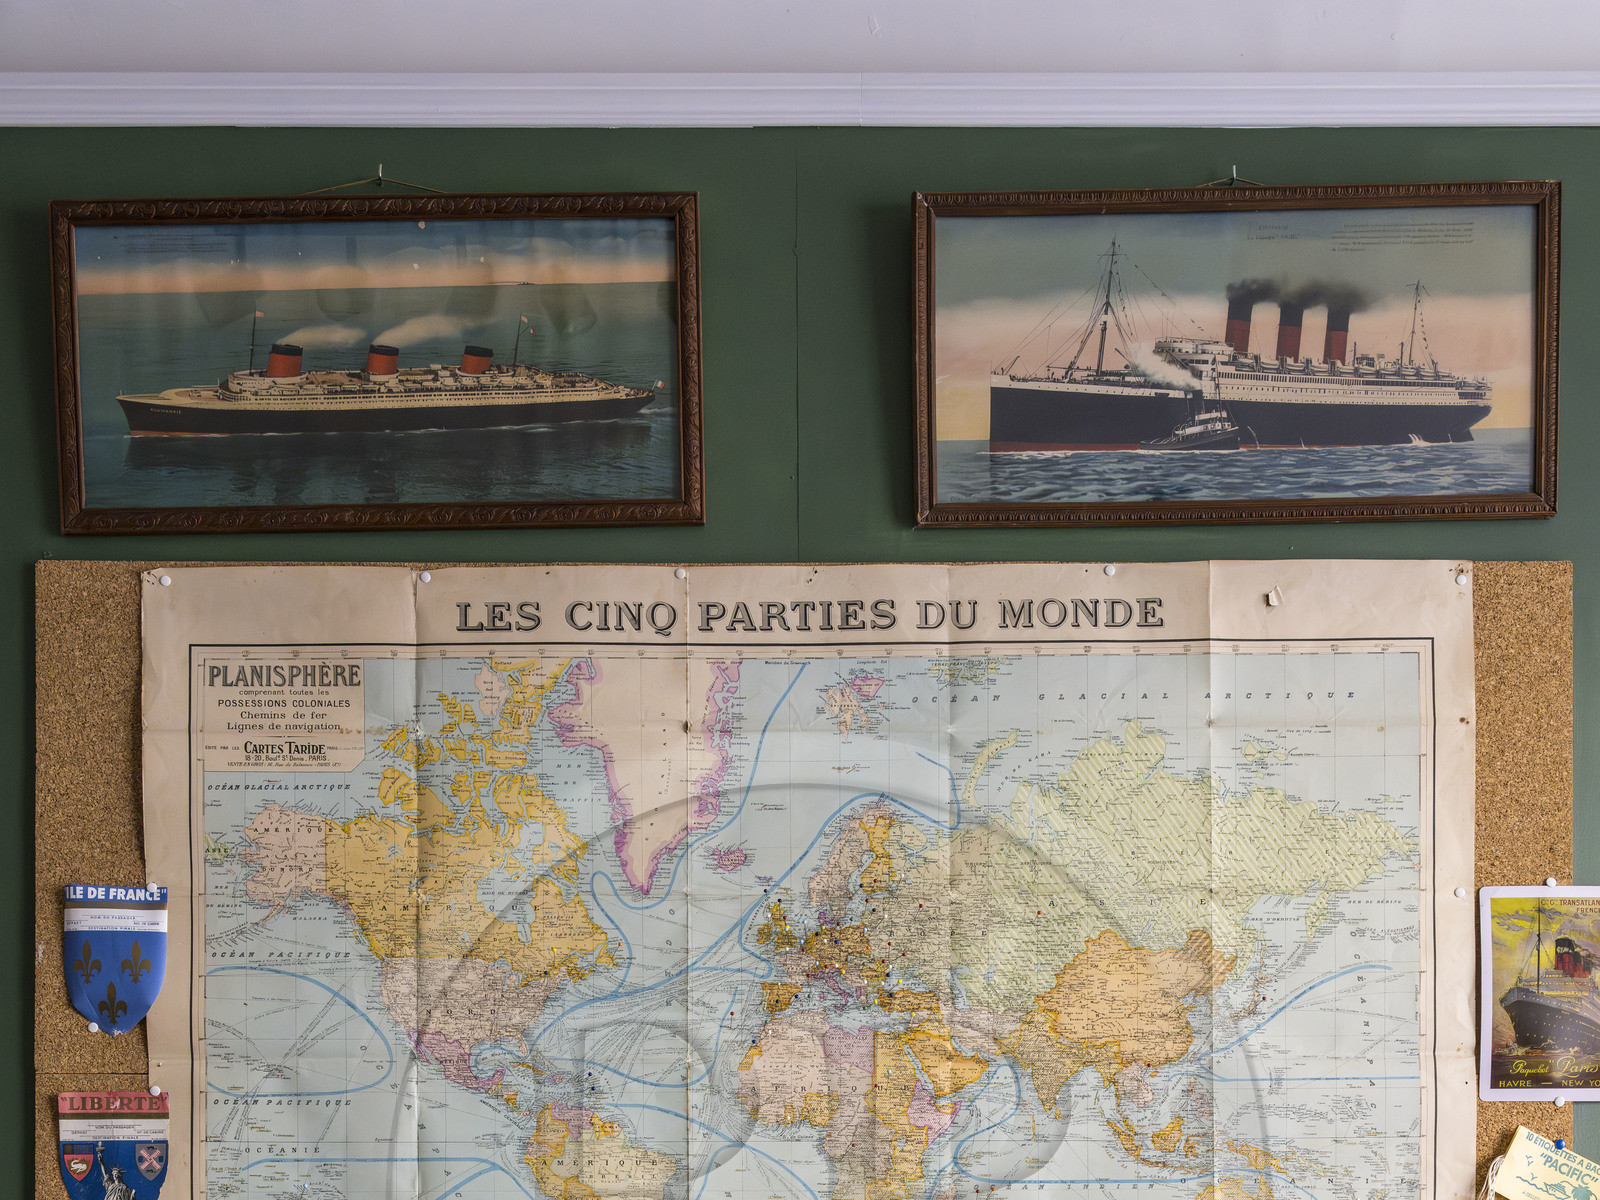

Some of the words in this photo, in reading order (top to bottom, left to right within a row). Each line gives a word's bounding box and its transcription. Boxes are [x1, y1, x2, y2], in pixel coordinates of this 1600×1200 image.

[455, 601, 543, 632] LES
[564, 600, 679, 636] CINQ
[697, 599, 898, 632] PARTIES
[916, 598, 978, 631] DU
[998, 597, 1165, 629] MONDE
[208, 661, 361, 687] PLANISPHÈRE
[218, 699, 287, 708] POSSESSIONS
[292, 699, 351, 708] COLONIALES
[912, 693, 1001, 704] OCÉAN
[1038, 692, 1168, 701] GLACIAL
[1204, 691, 1354, 700] ARCTIQUE
[240, 711, 286, 720] Chemins
[292, 711, 306, 720] de
[311, 711, 327, 720] fer
[227, 722, 264, 733] Lignes
[268, 722, 281, 731] de
[285, 722, 341, 733] navigation
[244, 740, 284, 754] CARTES
[285, 741, 326, 754] TARIDE
[207, 782, 240, 791] OCÉAN
[87, 887, 106, 899] DE
[211, 949, 256, 957] OCÉAN
[1509, 1059, 1549, 1077] Paquebot
[1499, 1080, 1532, 1088] HAVRE
[213, 1098, 259, 1106] OCÉAN
[1526, 1131, 1534, 1142] 10
[1533, 1136, 1578, 1163] ETIQUETTES
[1540, 1152, 1599, 1186] "PACIFIC"
